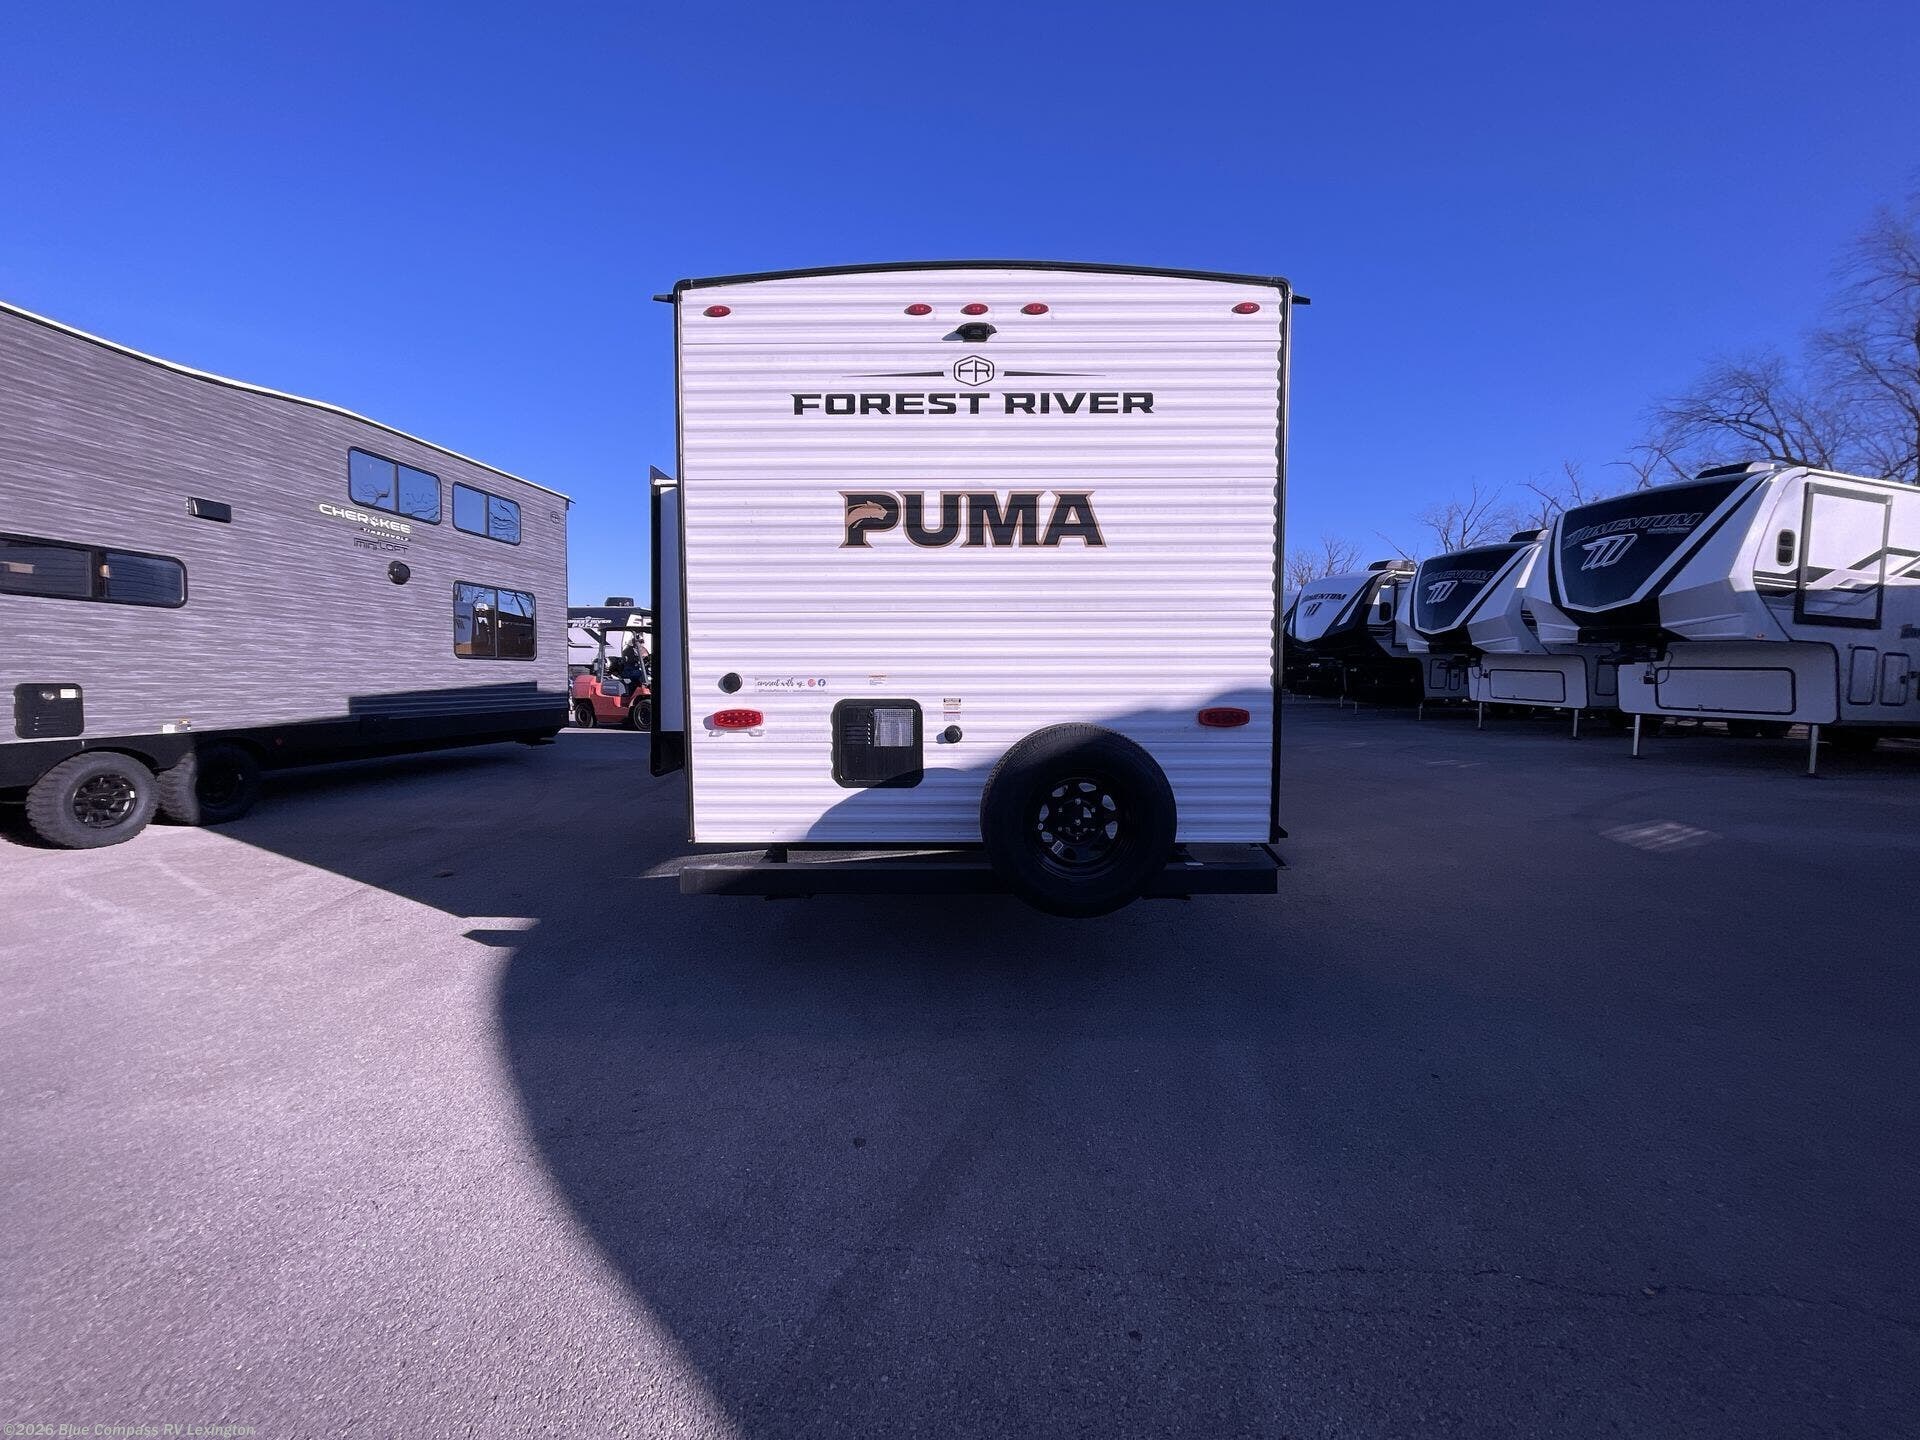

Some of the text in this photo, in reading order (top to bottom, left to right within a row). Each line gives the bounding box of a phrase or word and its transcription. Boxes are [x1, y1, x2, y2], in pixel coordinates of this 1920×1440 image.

[791, 392, 1155, 416] FOREST RIVER
[319, 503, 411, 534] CHEROKEE
[838, 490, 1107, 549] PUMA
